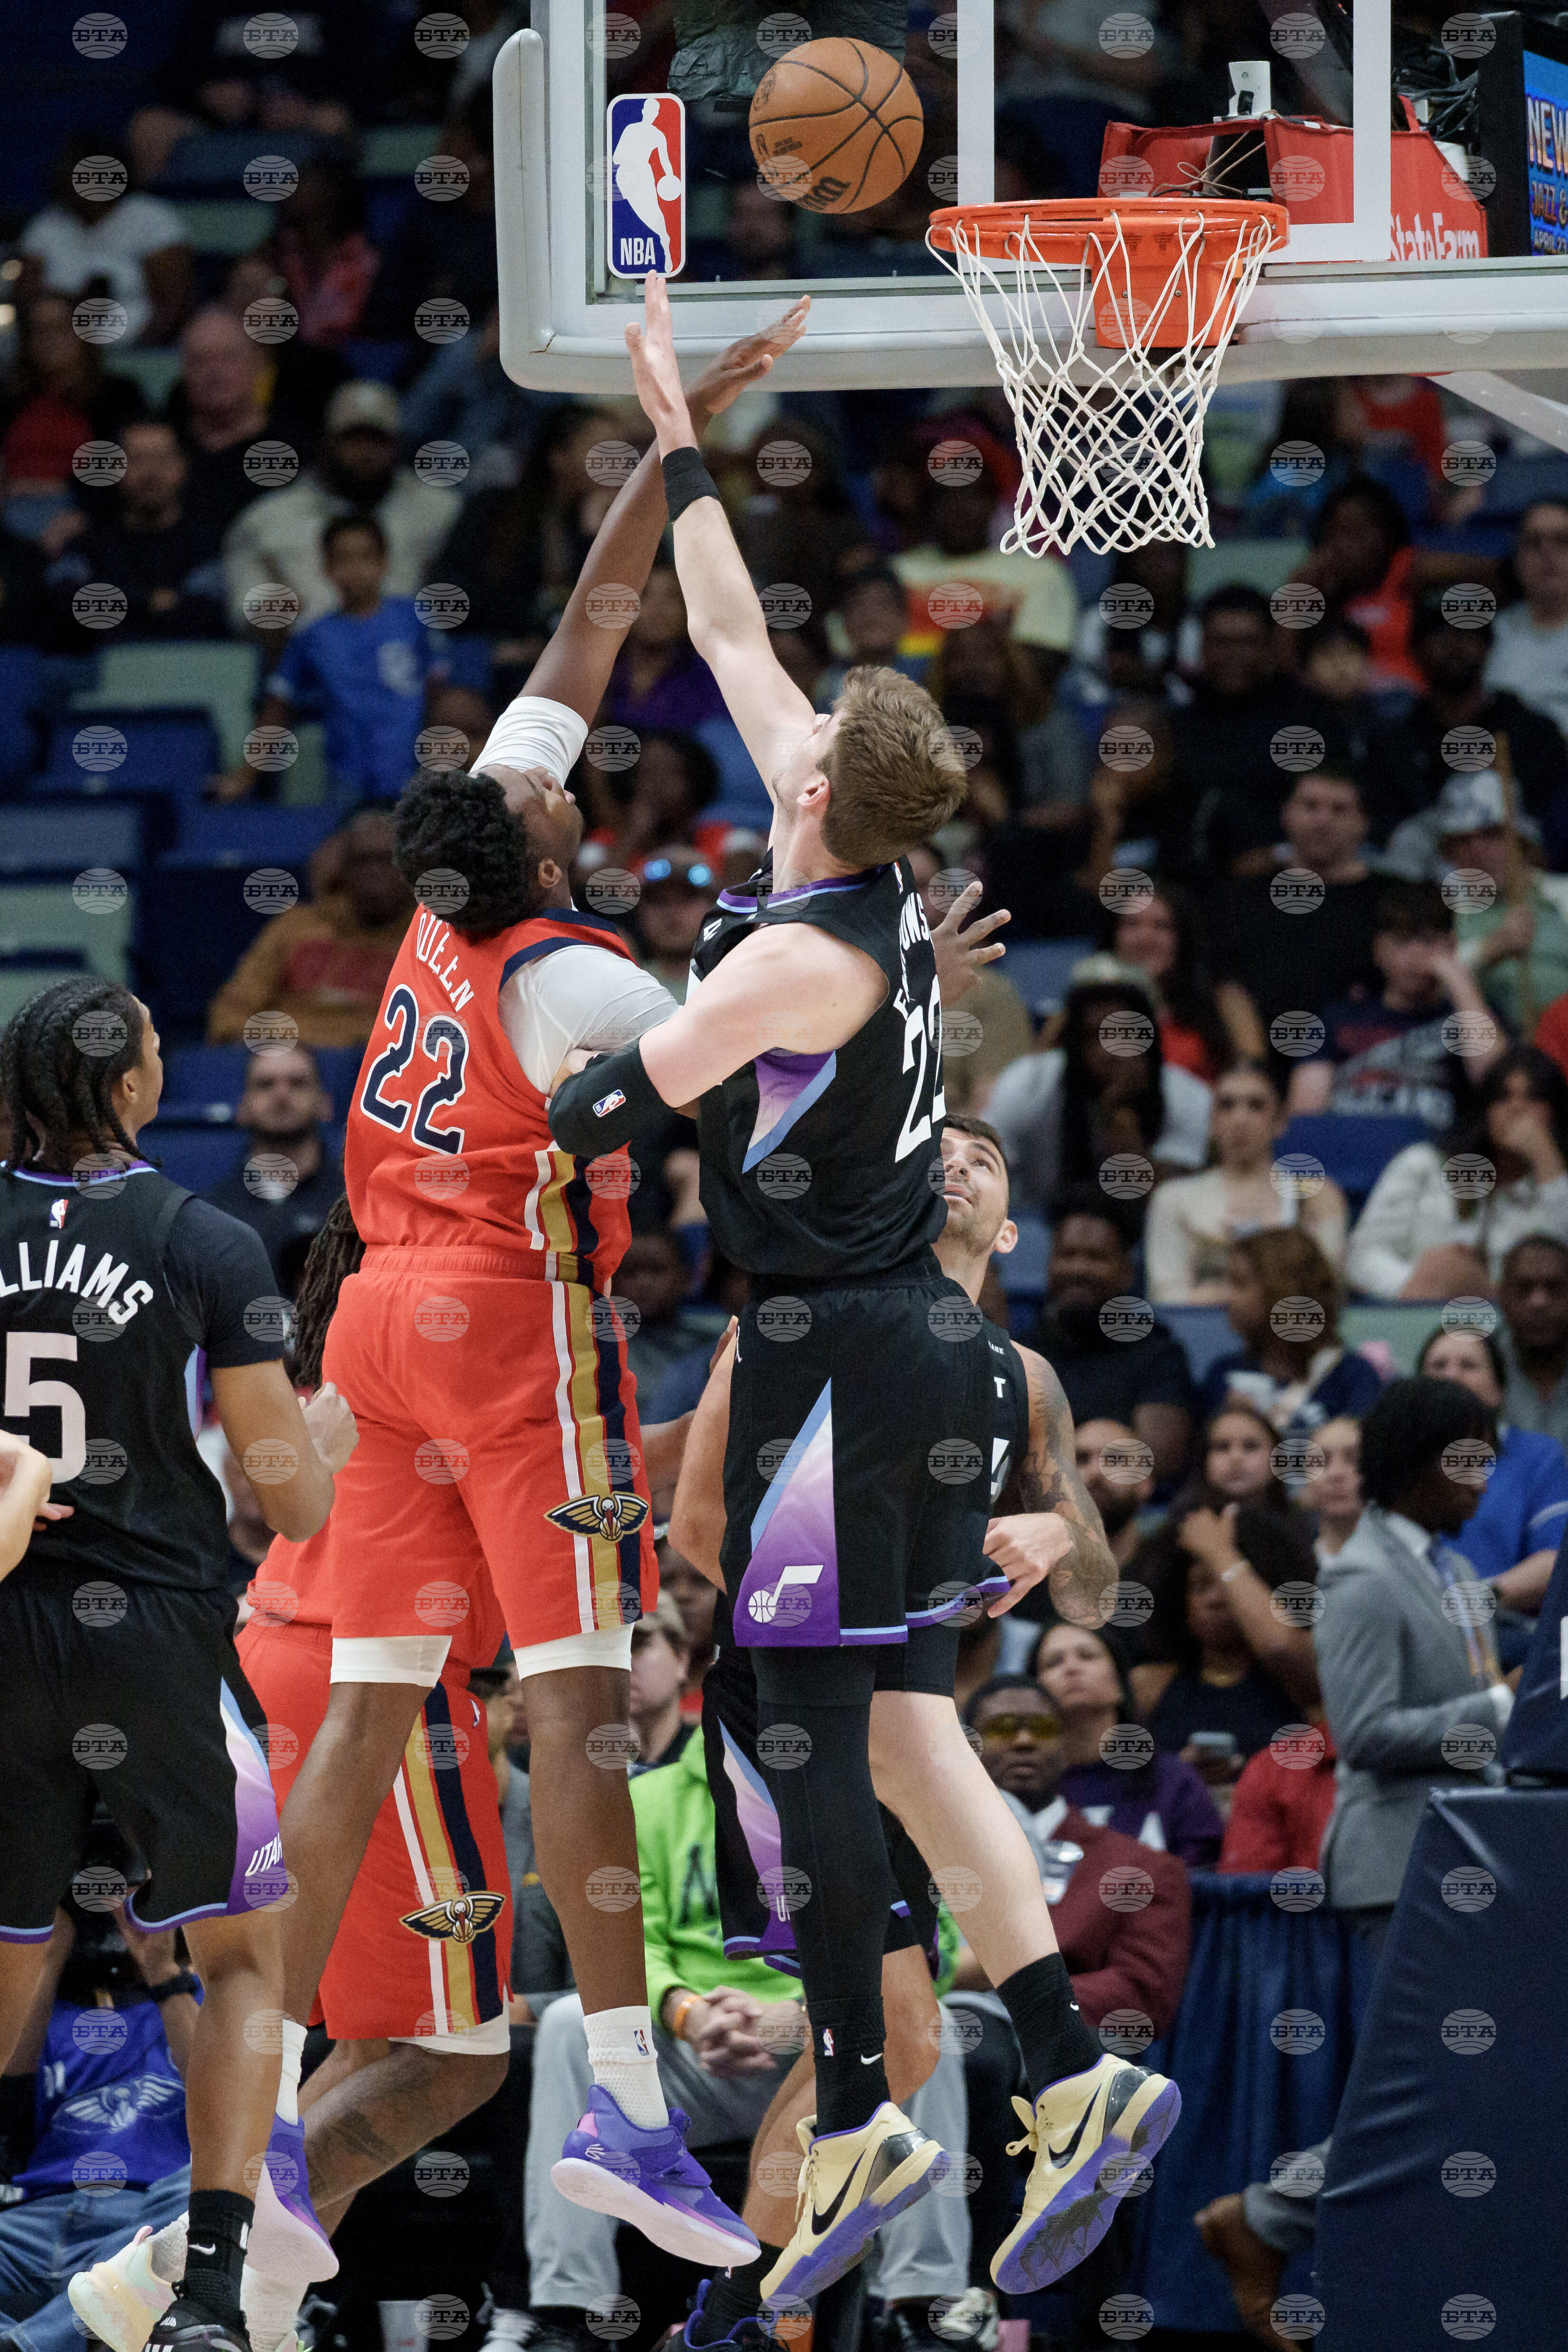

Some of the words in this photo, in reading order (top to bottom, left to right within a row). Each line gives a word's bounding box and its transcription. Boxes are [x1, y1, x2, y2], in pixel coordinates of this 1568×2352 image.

[620, 237, 656, 266] NBA
[416, 912, 474, 1013] QUEEN
[360, 983, 470, 1155] 22
[895, 973, 946, 1163] 22
[4, 1332, 86, 1484] 5
[245, 1831, 283, 1877] UTAH
